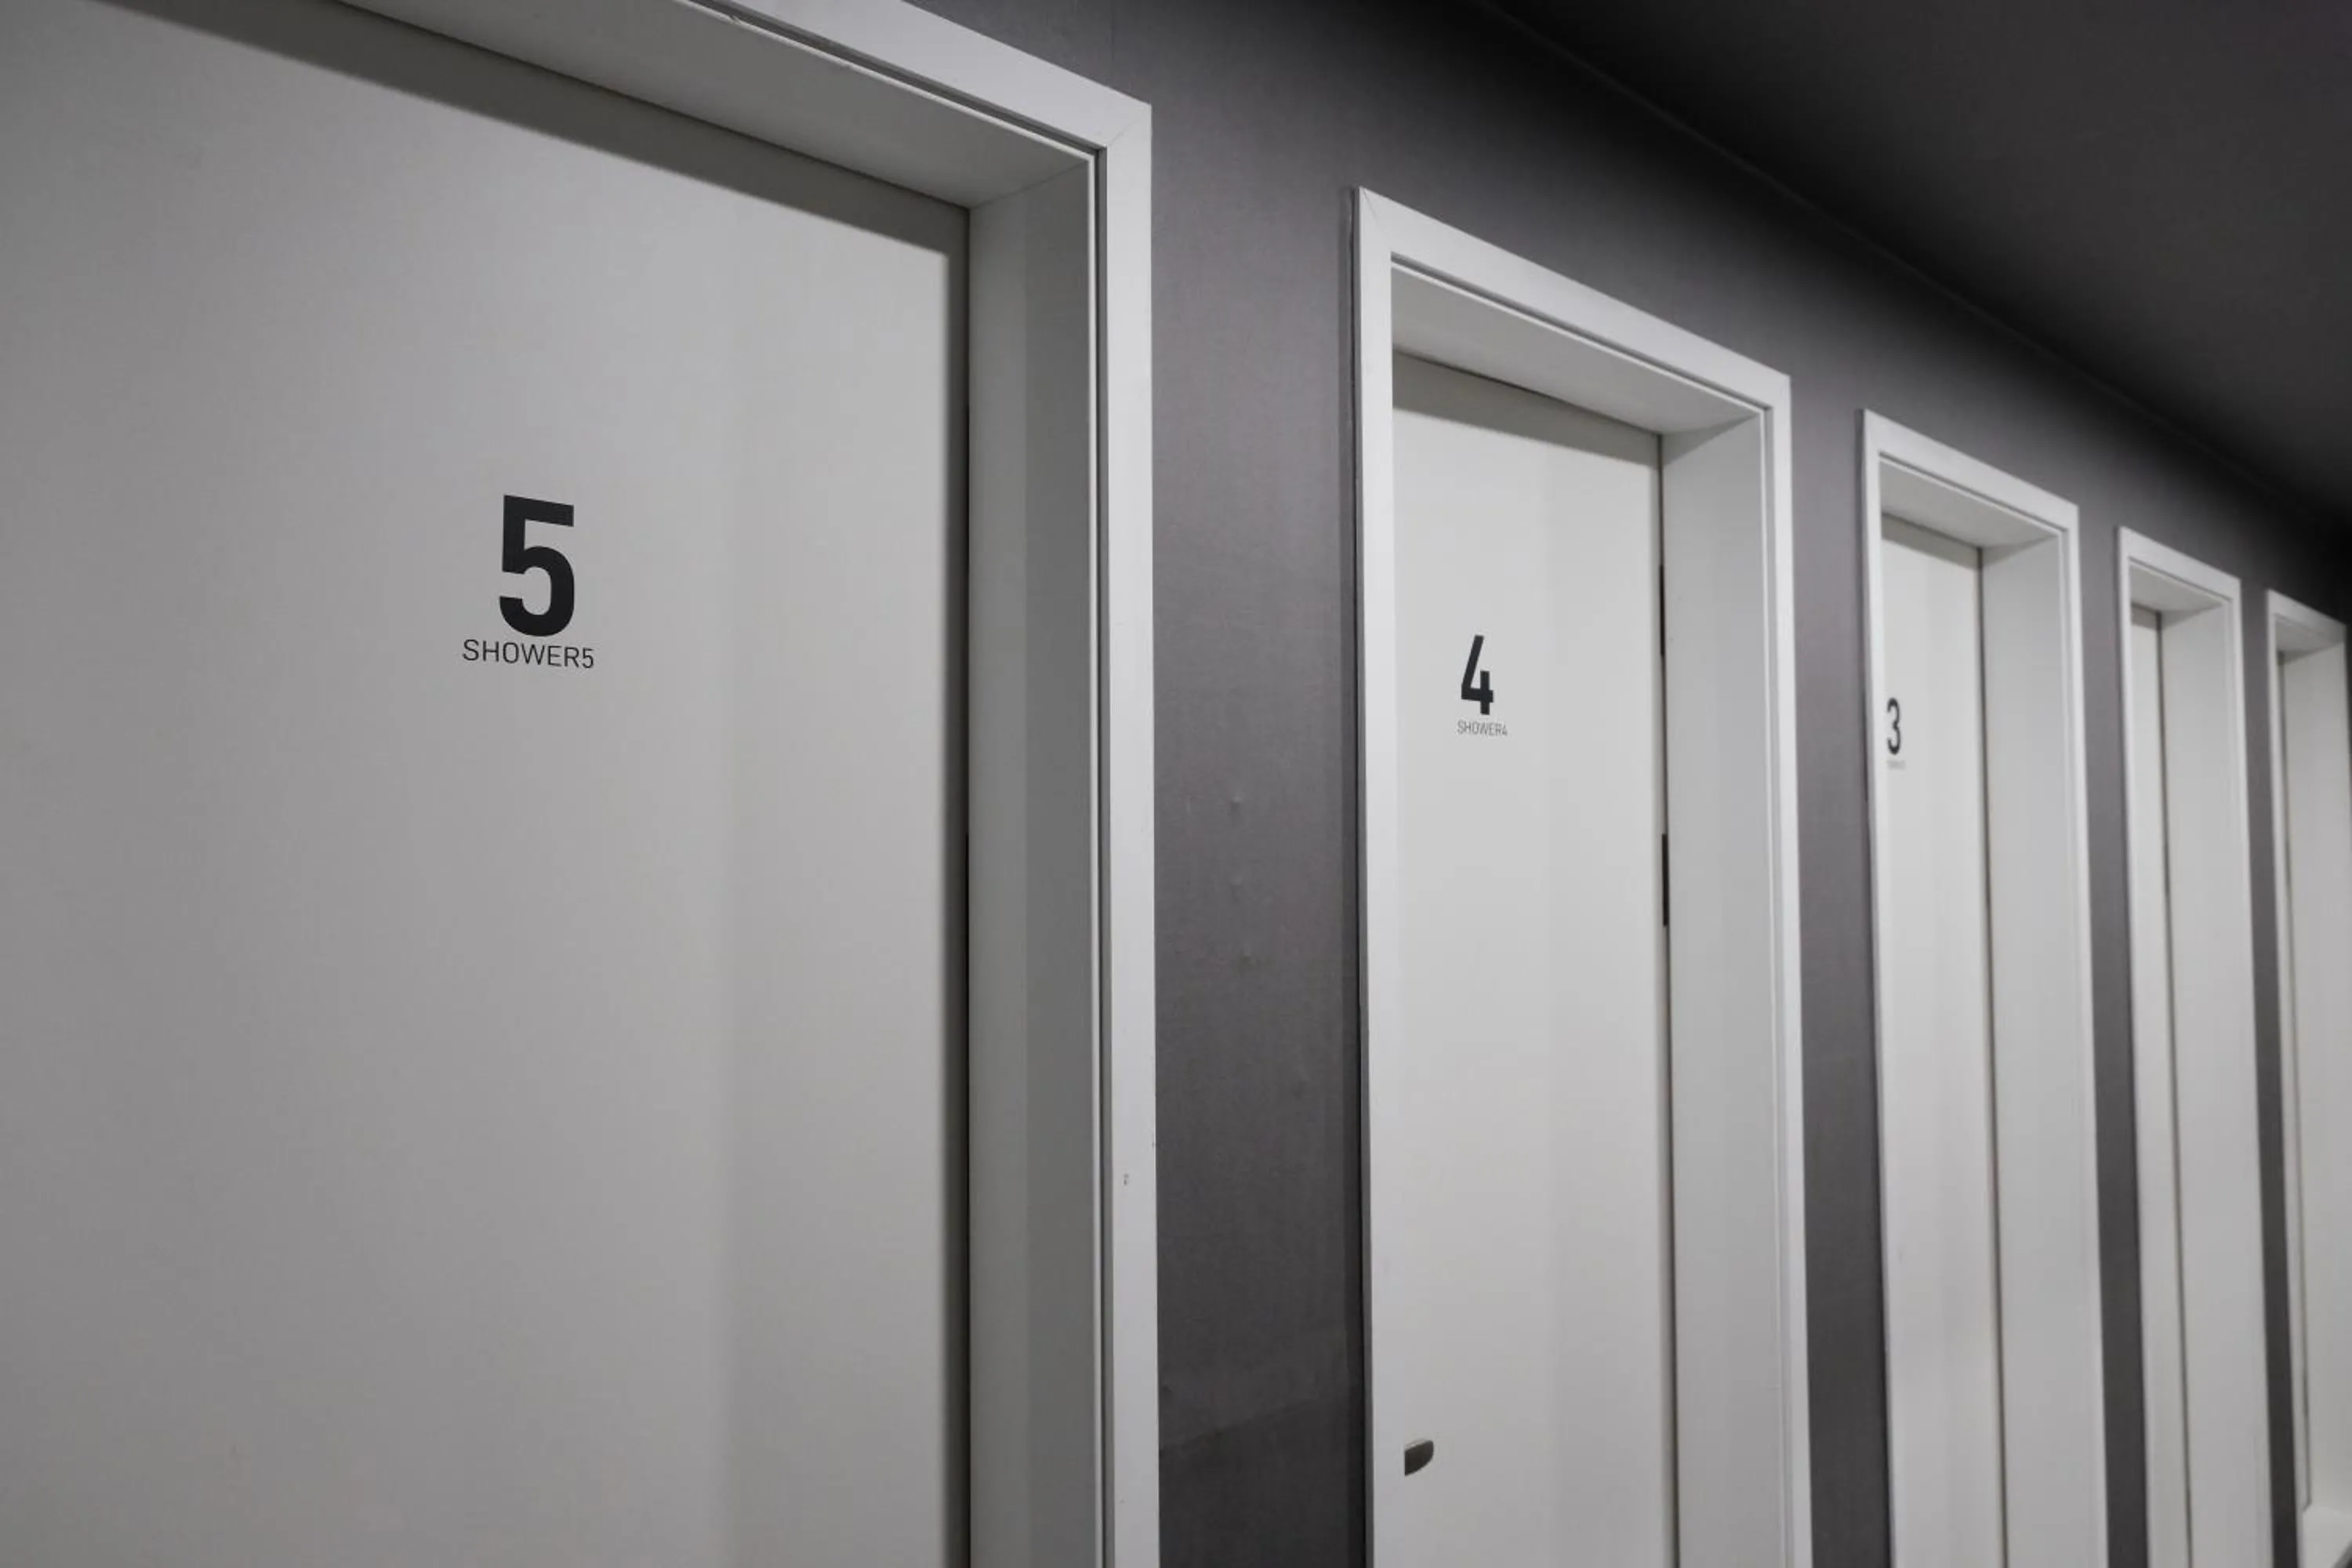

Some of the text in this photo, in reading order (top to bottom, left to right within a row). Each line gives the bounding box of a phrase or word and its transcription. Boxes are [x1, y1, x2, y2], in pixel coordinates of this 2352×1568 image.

[499, 495, 575, 637] 5
[463, 639, 594, 669] SHOWER5
[1461, 634, 1494, 715] 4
[1887, 697, 1901, 755] 3
